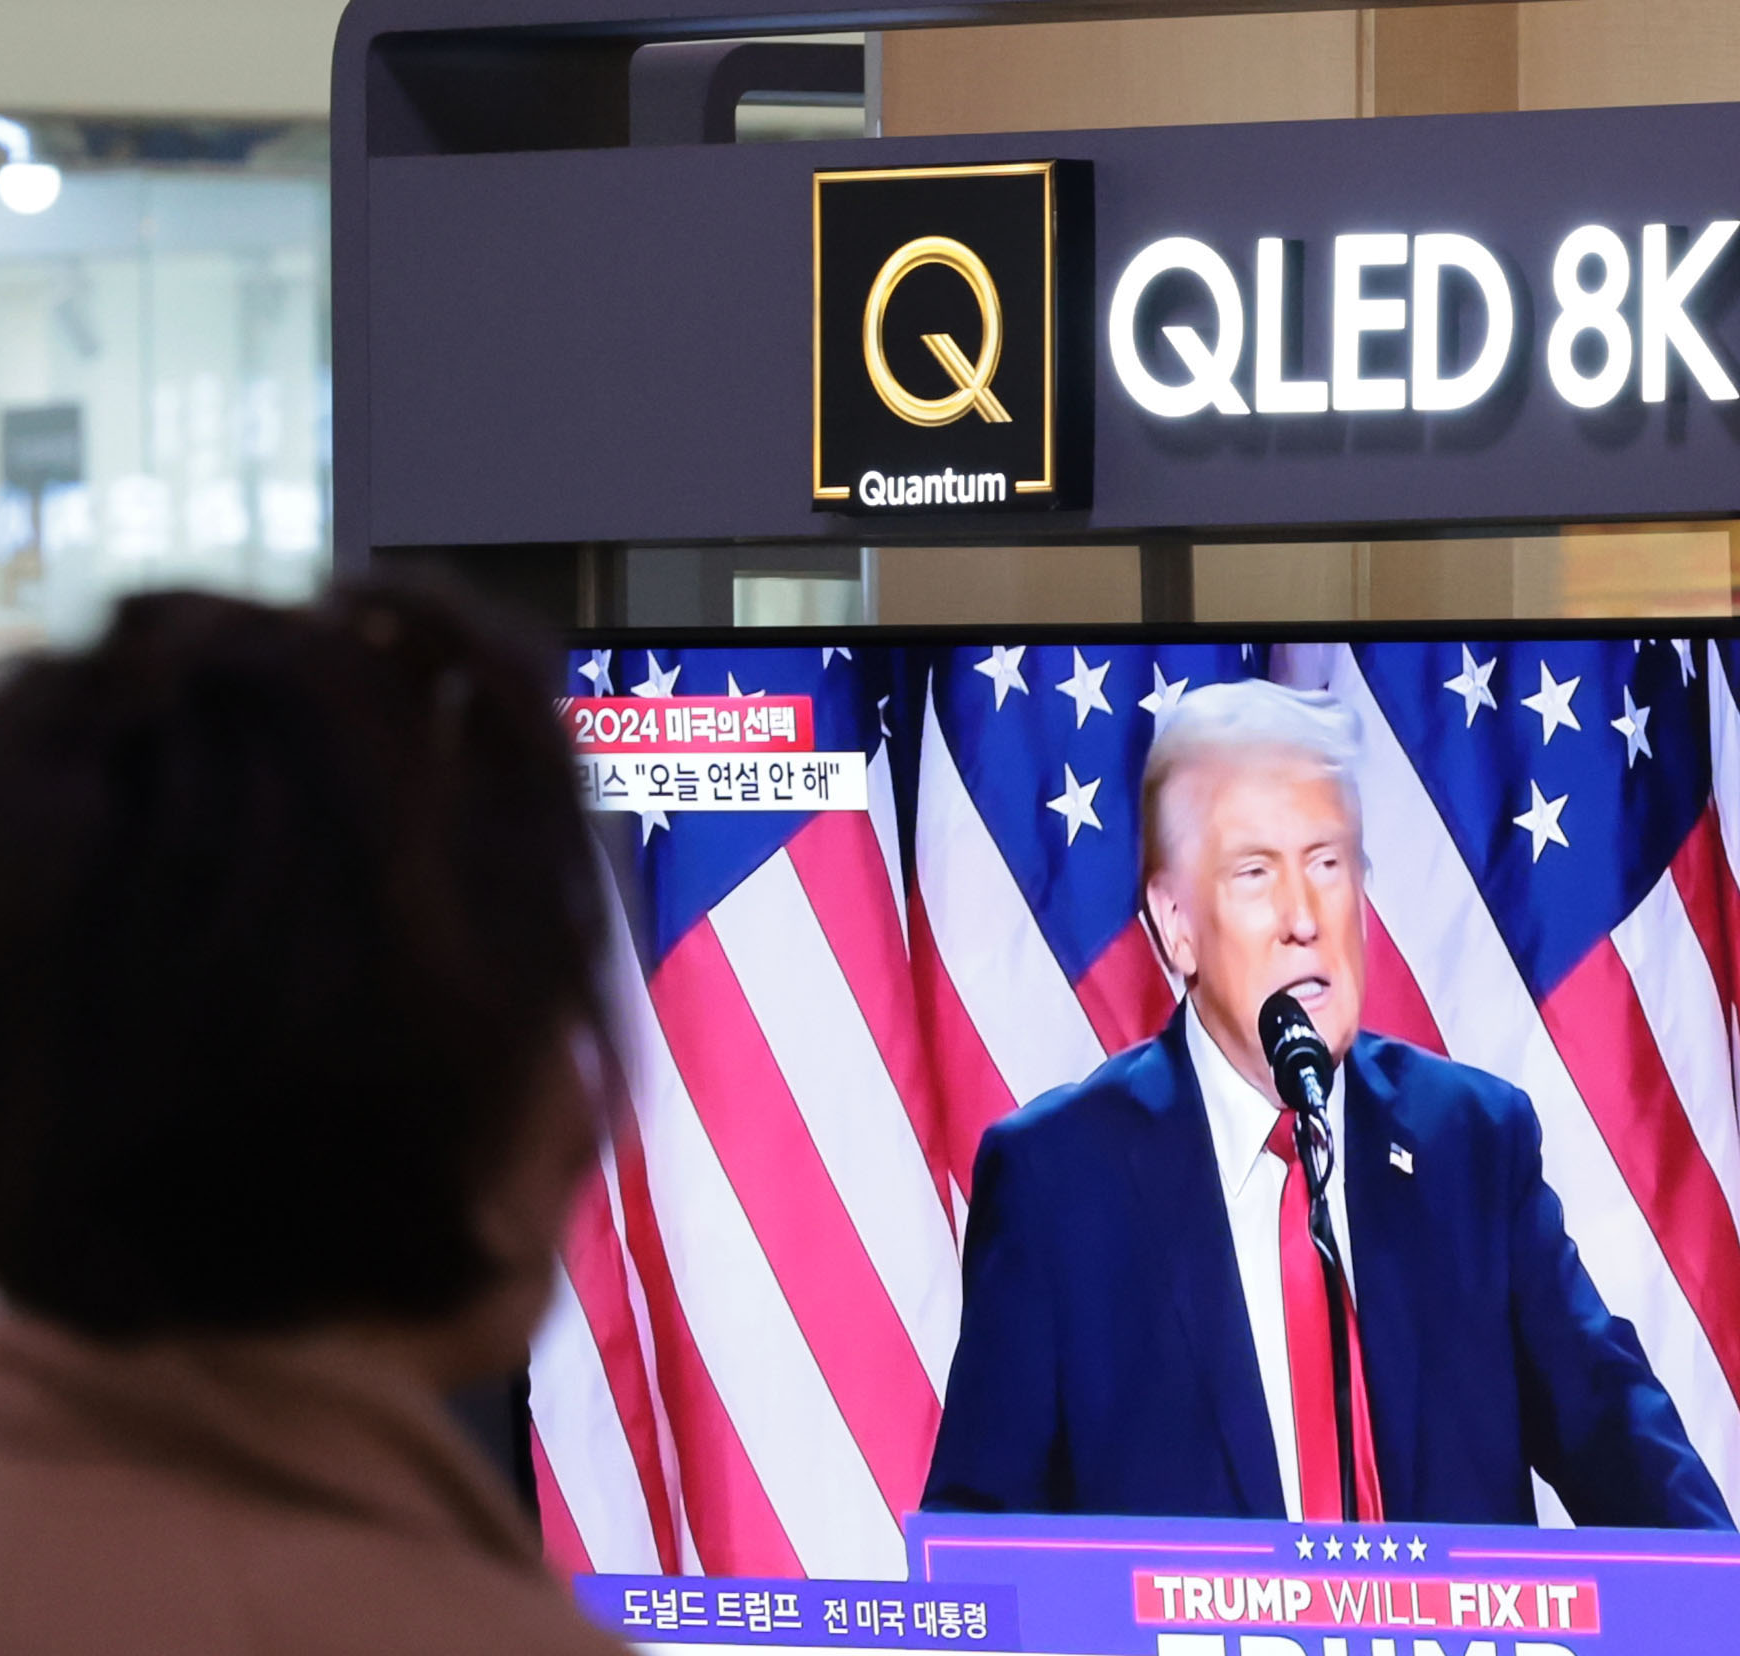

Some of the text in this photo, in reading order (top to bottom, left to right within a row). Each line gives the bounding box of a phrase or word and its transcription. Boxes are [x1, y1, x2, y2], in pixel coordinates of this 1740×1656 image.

[862, 236, 1013, 427] Q
[1107, 231, 1515, 418] QLED
[858, 467, 1007, 507] Quantum
[575, 707, 659, 743] 2024
[635, 762, 700, 801] "오늘
[708, 762, 761, 801] 연설
[769, 761, 794, 800] 안
[801, 761, 840, 800] 해"
[622, 1588, 989, 1640] 도널드 트럼프 전 미국 대통령
[1153, 1575, 1579, 1629] TRUMP WILL FIX IT
